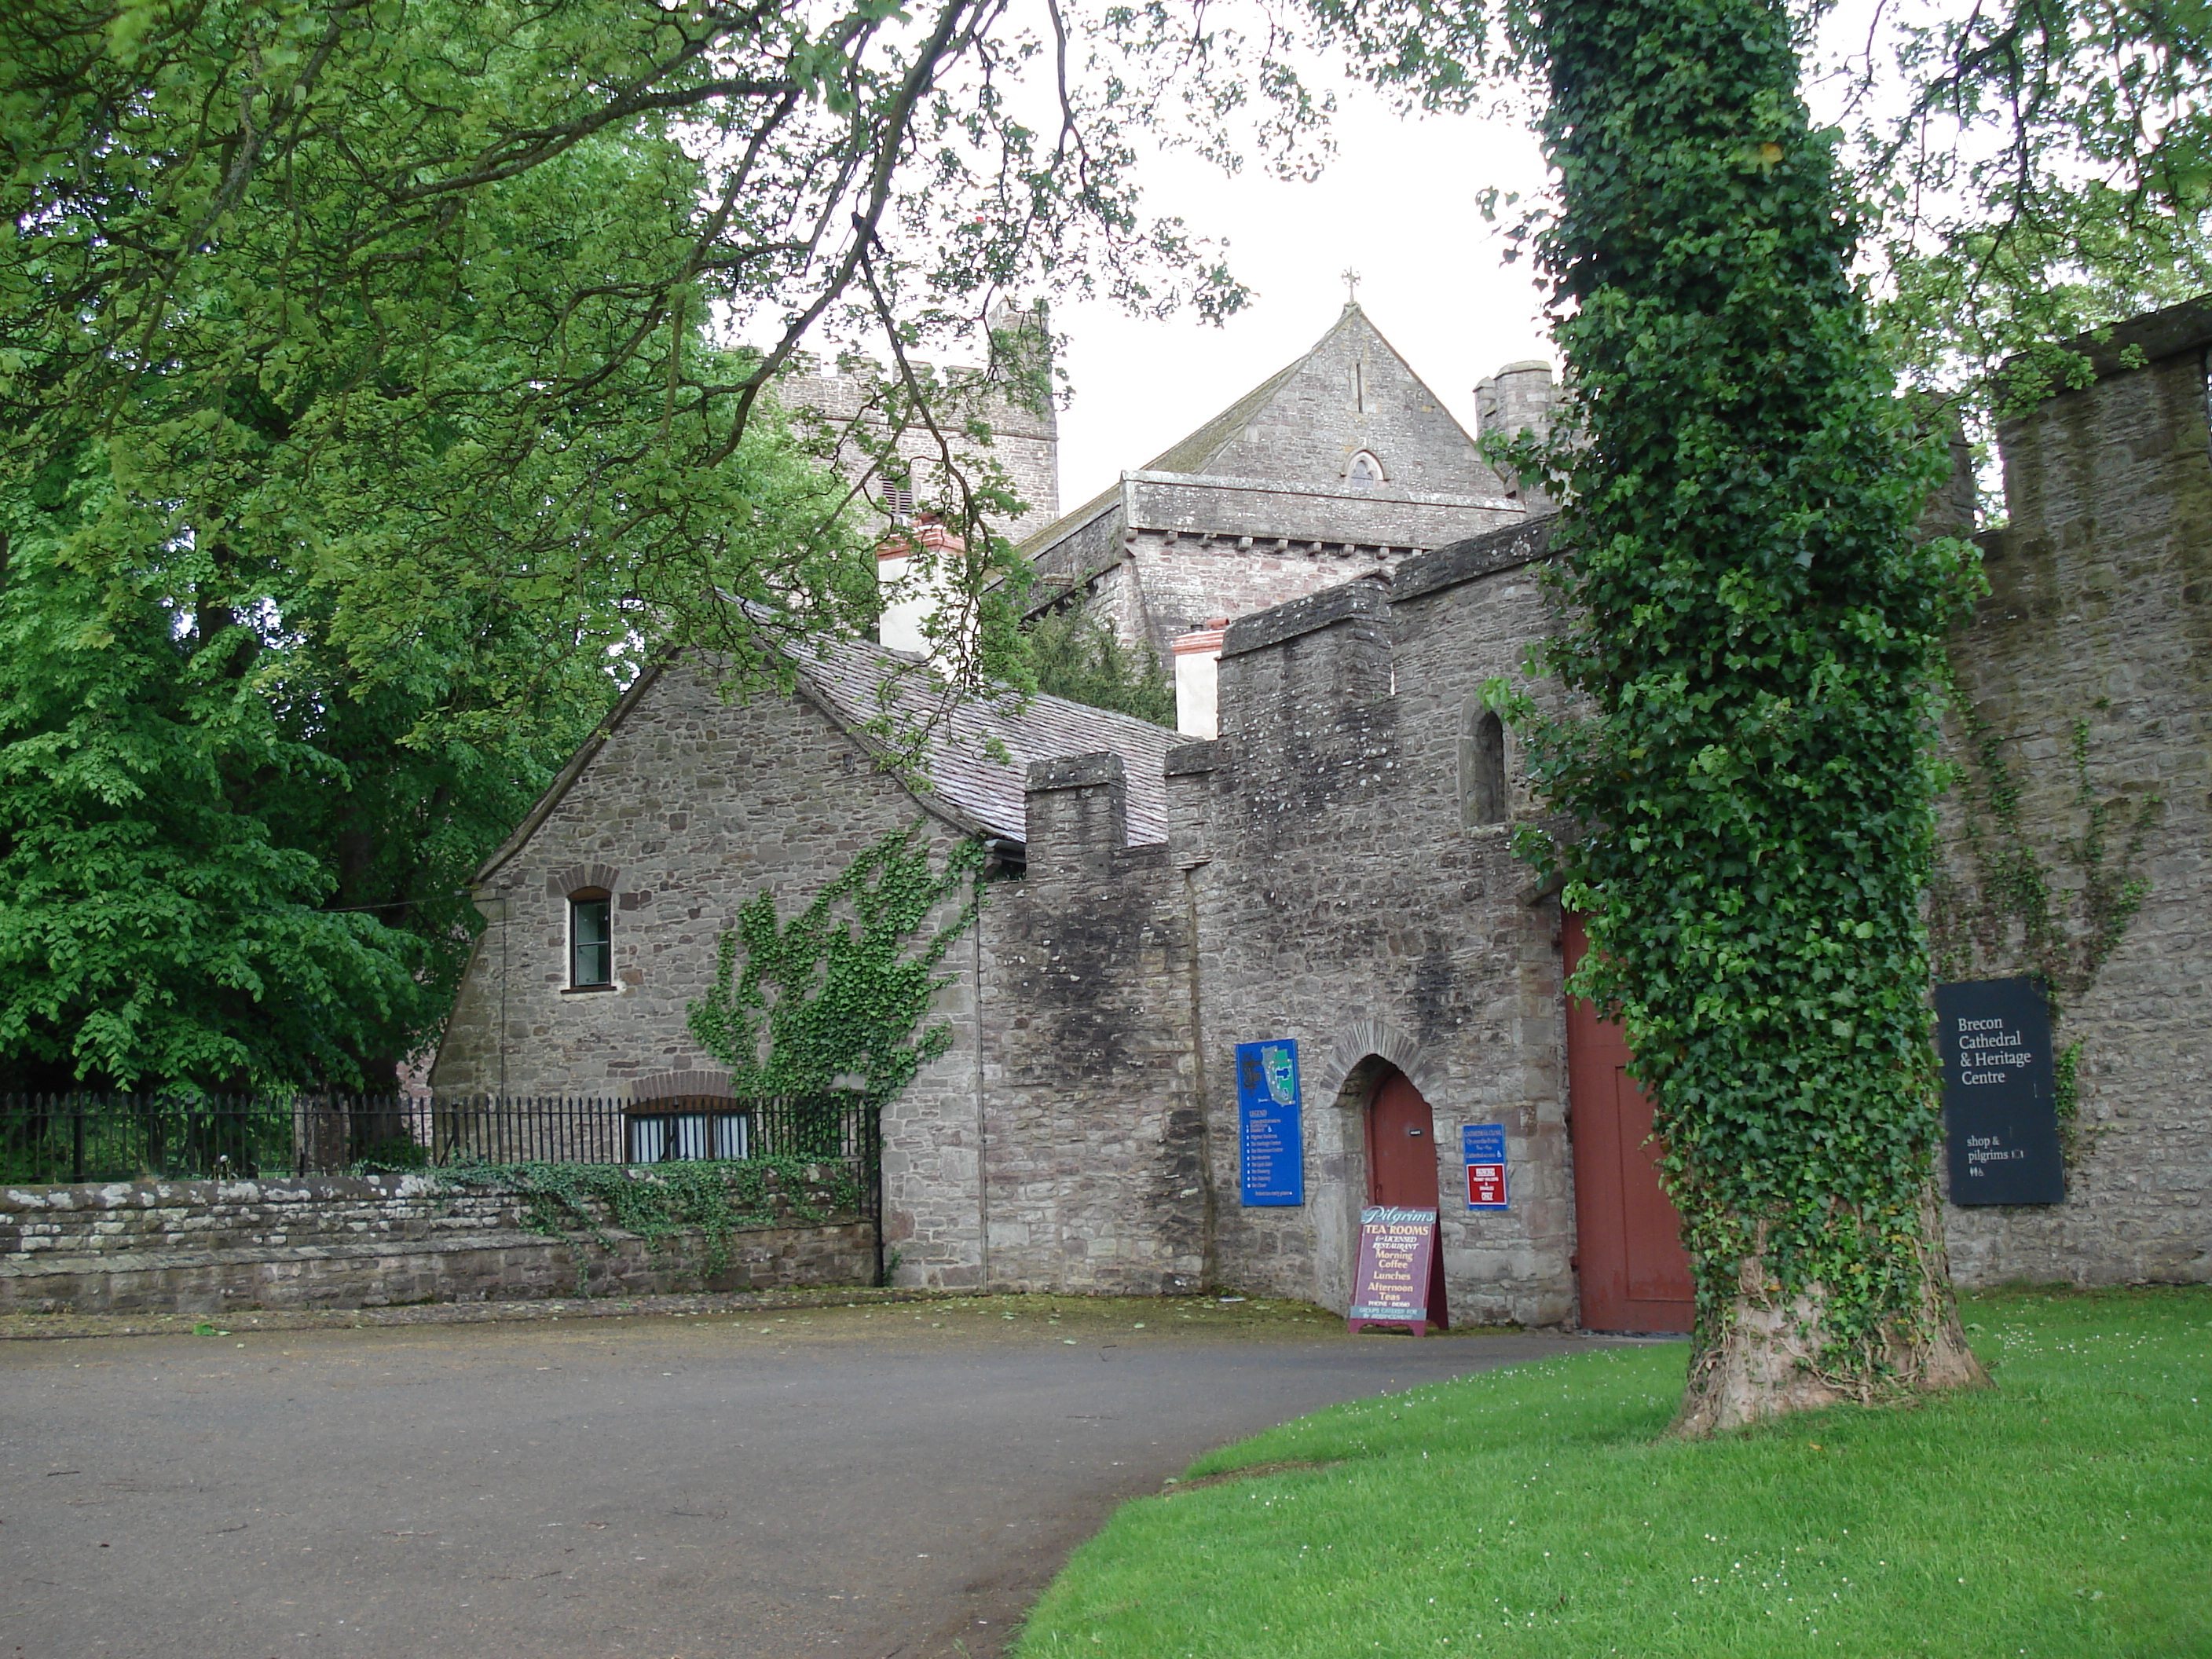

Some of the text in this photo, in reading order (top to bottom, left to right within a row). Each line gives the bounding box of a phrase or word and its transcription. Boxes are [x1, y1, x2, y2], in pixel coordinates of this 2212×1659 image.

[1957, 1018, 2003, 1032] Brecon
[1959, 1031, 2022, 1049] Cathedral
[1960, 1050, 2031, 1068] & Heritage
[1961, 1071, 2005, 1086] Centre
[1967, 1136, 1999, 1148] shop &
[1968, 1150, 2009, 1163] pilgrims
[1361, 1206, 1434, 1225] Pilgrims
[1366, 1225, 1429, 1236] TEA ROOMS
[1372, 1243, 1419, 1251] RESTAURANT
[1375, 1251, 1413, 1262] Morning
[1379, 1259, 1408, 1269] Coffee
[1373, 1271, 1411, 1280] Lunches
[1368, 1282, 1413, 1292] Afternoon
[1379, 1291, 1401, 1301] Teas
